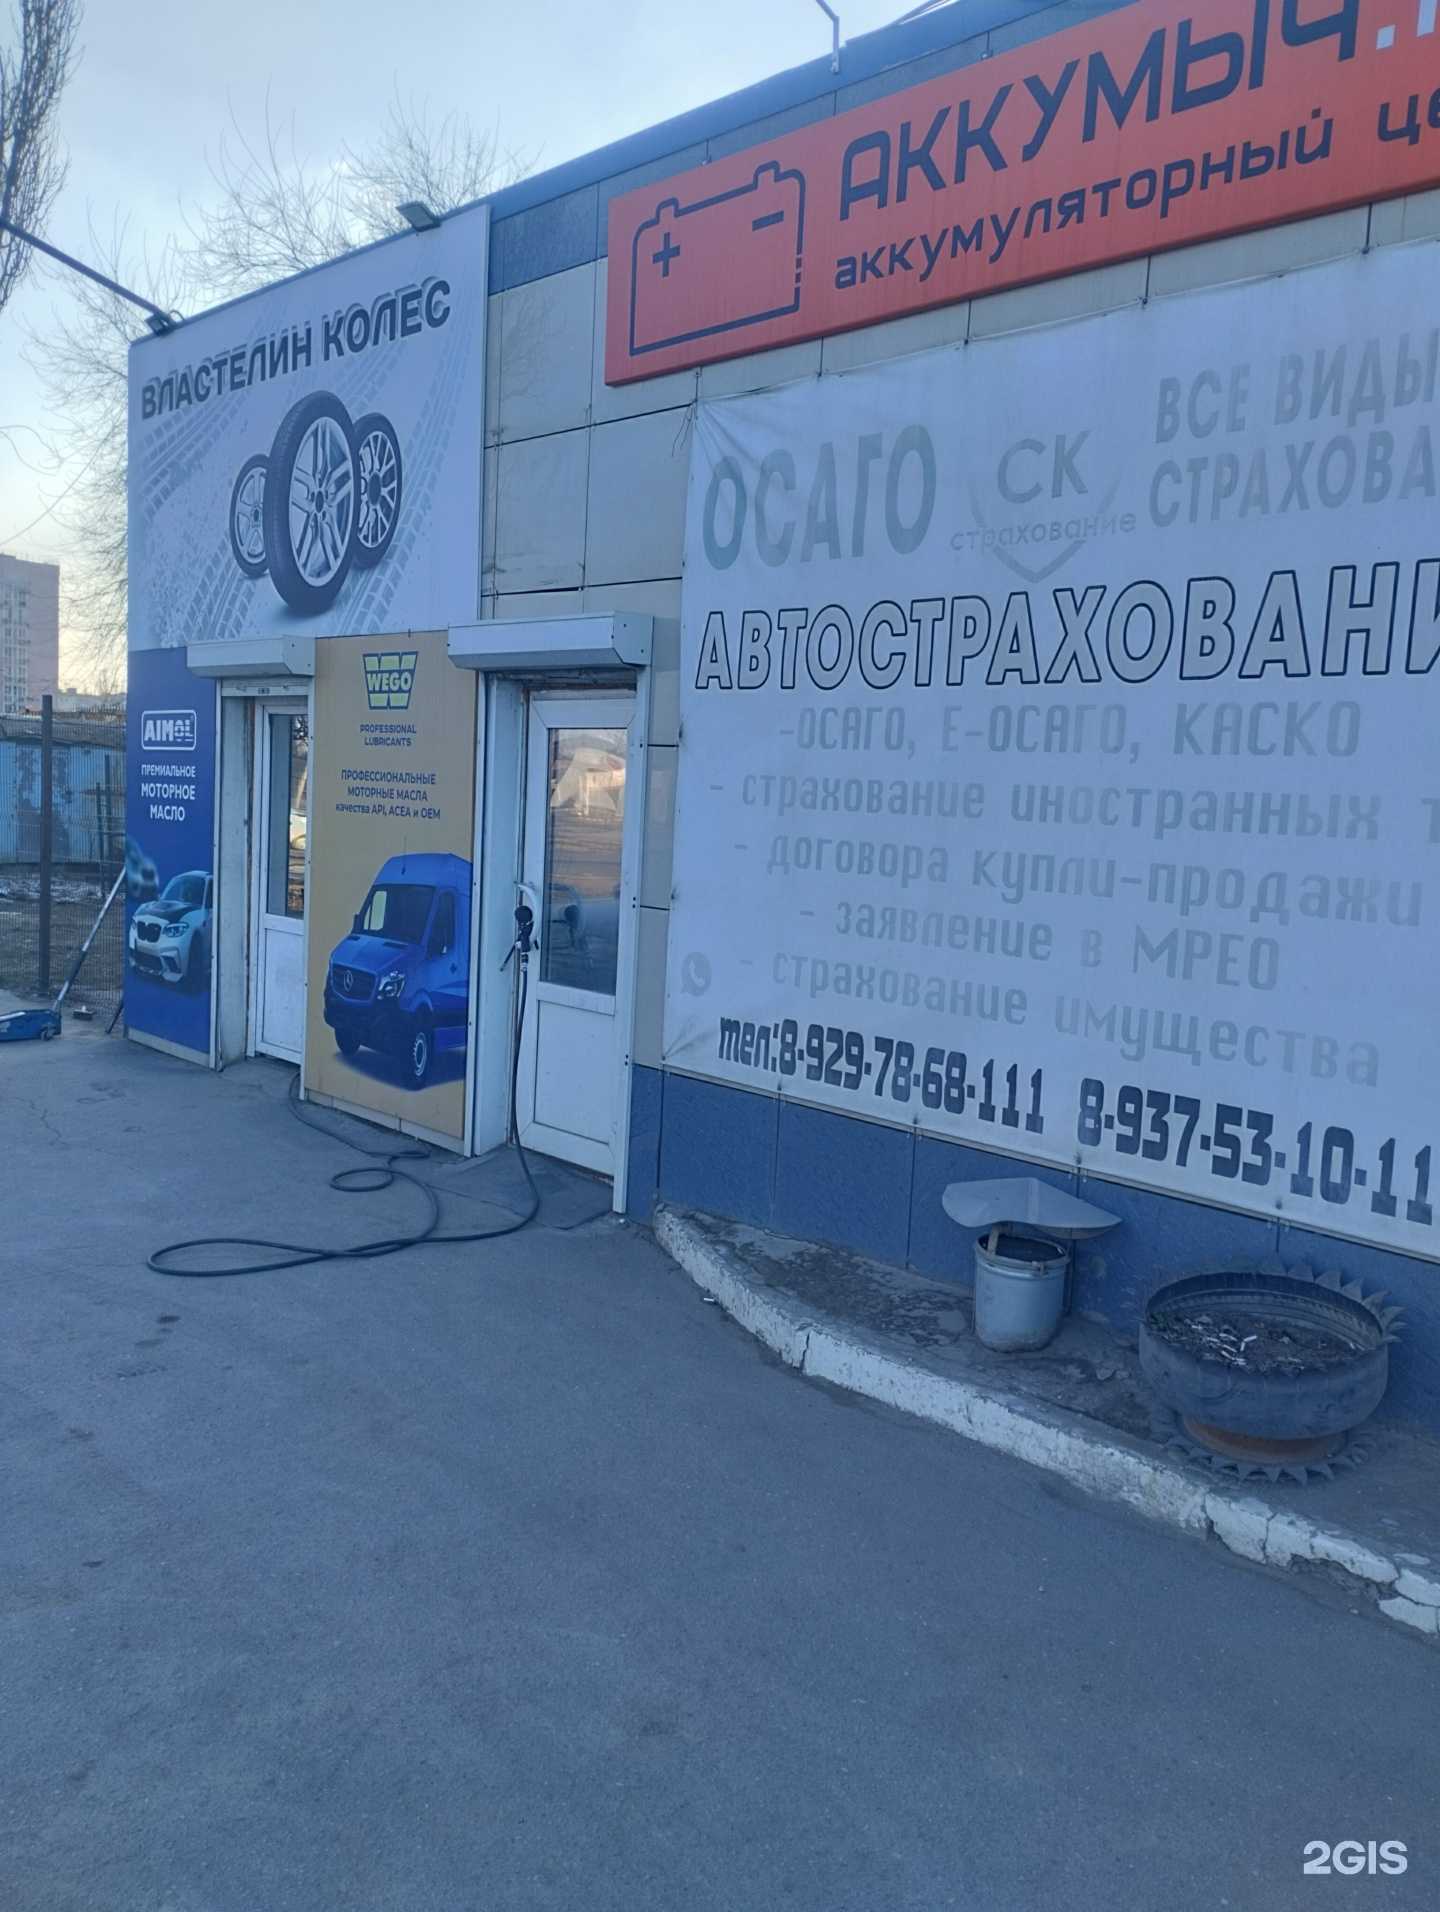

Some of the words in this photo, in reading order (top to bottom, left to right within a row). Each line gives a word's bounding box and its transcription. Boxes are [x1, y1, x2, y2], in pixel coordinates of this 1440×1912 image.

[839, 0, 1440, 222] АККУМЫЧ.
[834, 107, 1334, 290] аккумуляторный
[141, 324, 312, 420] ВЛАСТЕЛИН
[323, 279, 451, 363] КОЛЕС
[1156, 364, 1250, 444] ВСЕ
[1273, 329, 1440, 429] ВИДЫ
[998, 430, 1091, 504] СК
[702, 424, 937, 571] ОСАГО
[951, 513, 1137, 557] страхование
[366, 671, 412, 692] WEGO
[359, 723, 417, 734] PROFESSIONAL
[364, 737, 412, 747] LUBRICANTS
[1173, 700, 1361, 758] КАСКО
[141, 764, 196, 778] ПРЕМИАЛЬНОЕ
[141, 783, 196, 800] МОТОРНОЕ
[341, 769, 436, 785] ПРОФЕССИОНАЛЬНЫЕ
[347, 786, 395, 800] МОТОРНЫЕ
[396, 789, 428, 802] МАСЛА
[150, 804, 185, 822] МАСЛО
[335, 804, 370, 814] качества
[742, 774, 985, 819] страхование
[1010, 783, 1381, 840] иностранных
[767, 834, 950, 888] договора
[972, 848, 1423, 927] купли-продажи
[835, 901, 1053, 961] заявление
[1080, 928, 1104, 968] в
[1132, 924, 1280, 991] МРЕО
[772, 951, 1028, 1025] страхование
[1054, 995, 1380, 1087] имущества
